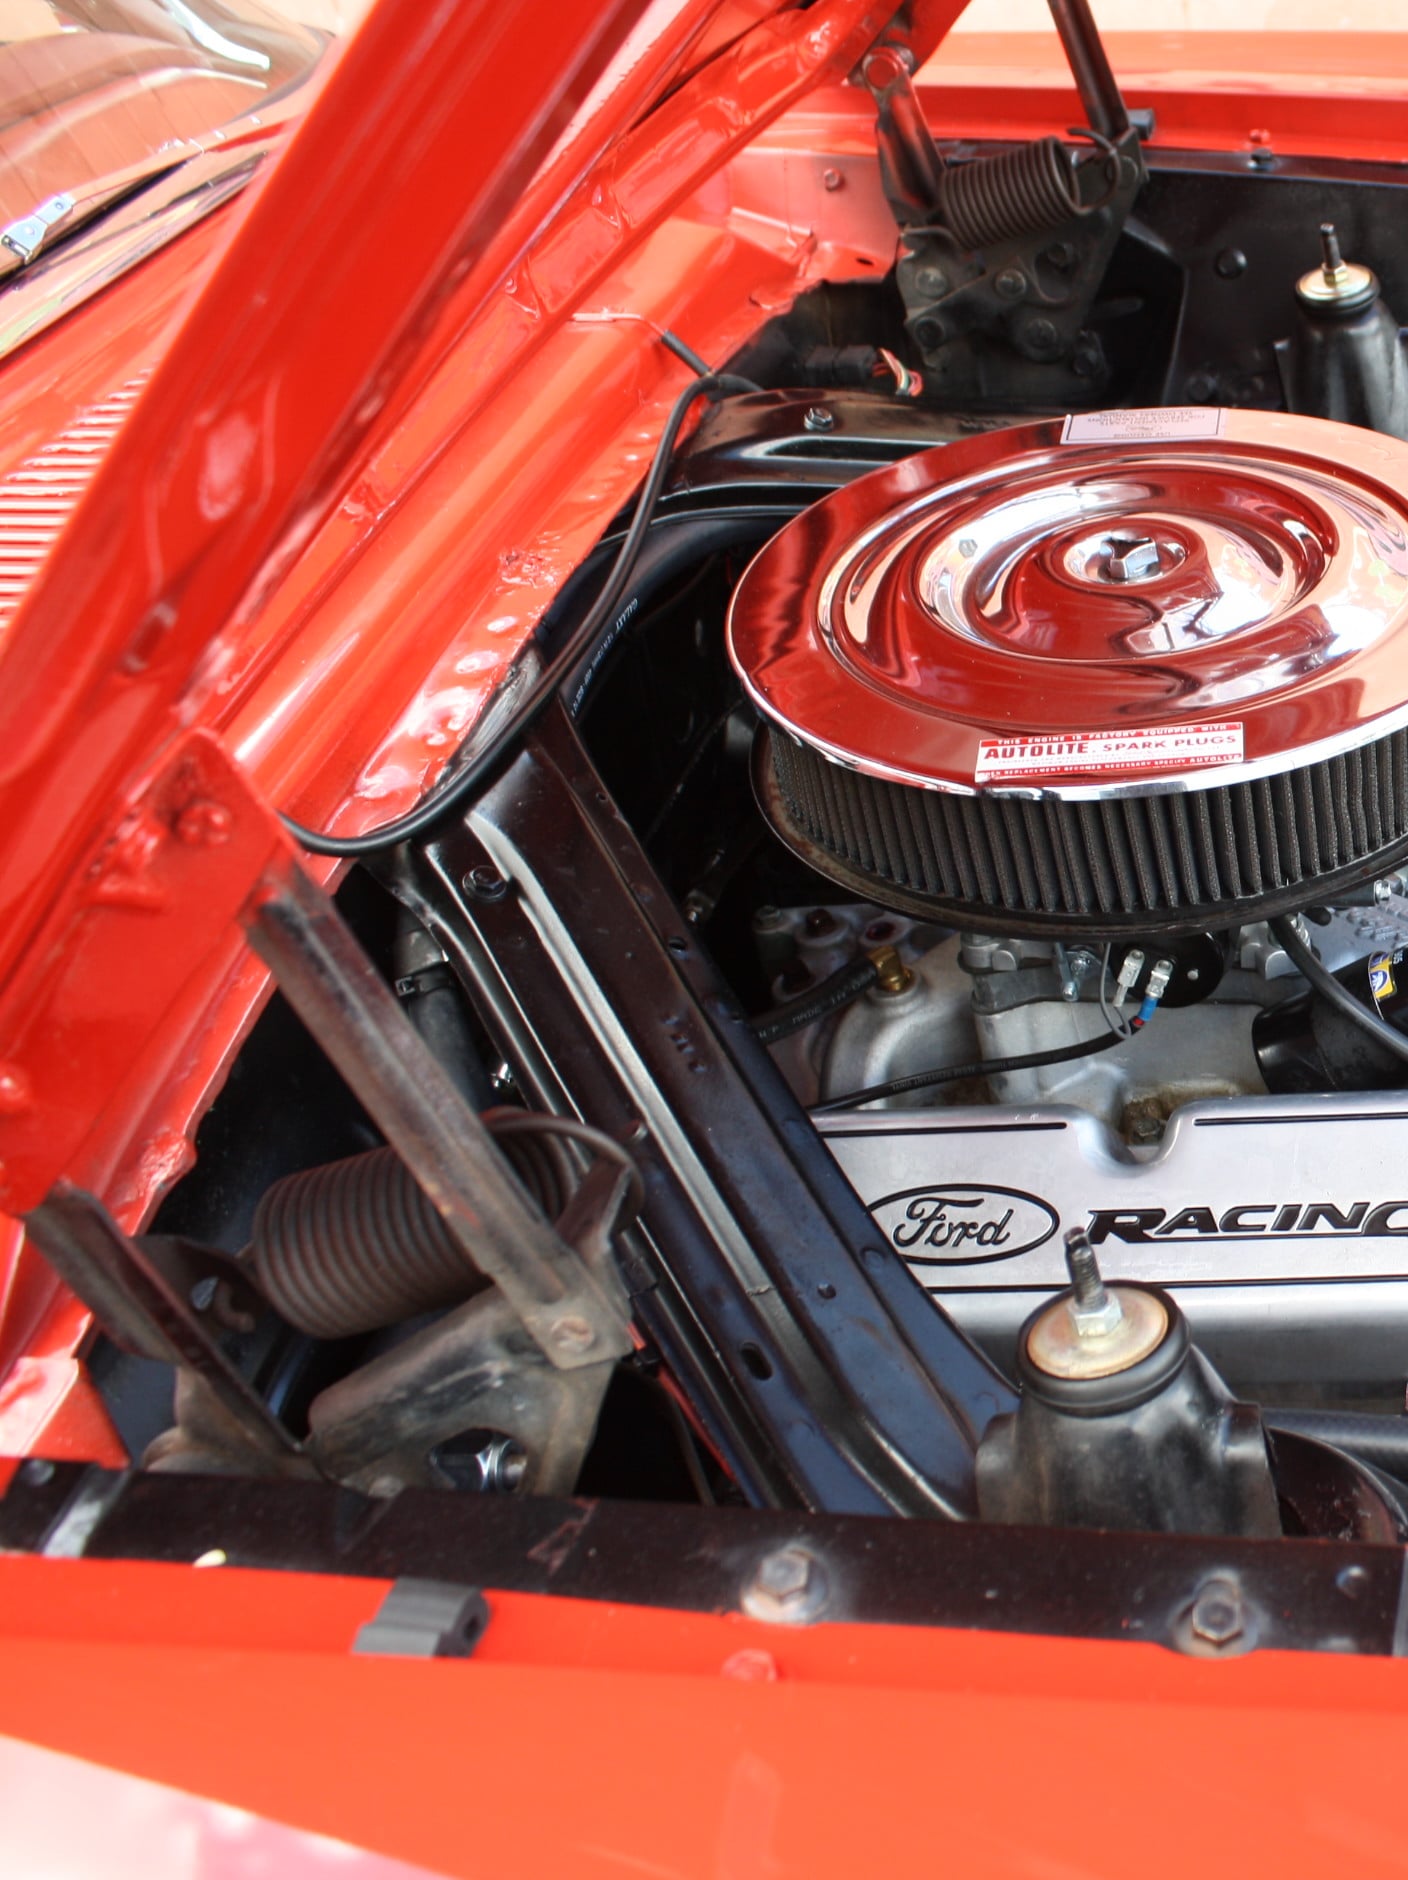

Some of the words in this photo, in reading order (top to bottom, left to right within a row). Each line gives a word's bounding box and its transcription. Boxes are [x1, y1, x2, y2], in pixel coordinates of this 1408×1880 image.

[1028, 735, 1065, 743] ENGINE
[1089, 731, 1136, 740] FACTORY
[1143, 727, 1194, 736] EQUIPPED
[1201, 724, 1227, 732] WITH
[984, 742, 1089, 760] AUTOLITE
[1103, 740, 1166, 752] SPARK
[1174, 735, 1237, 747] PLUGS
[891, 1197, 1014, 1249] Ford
